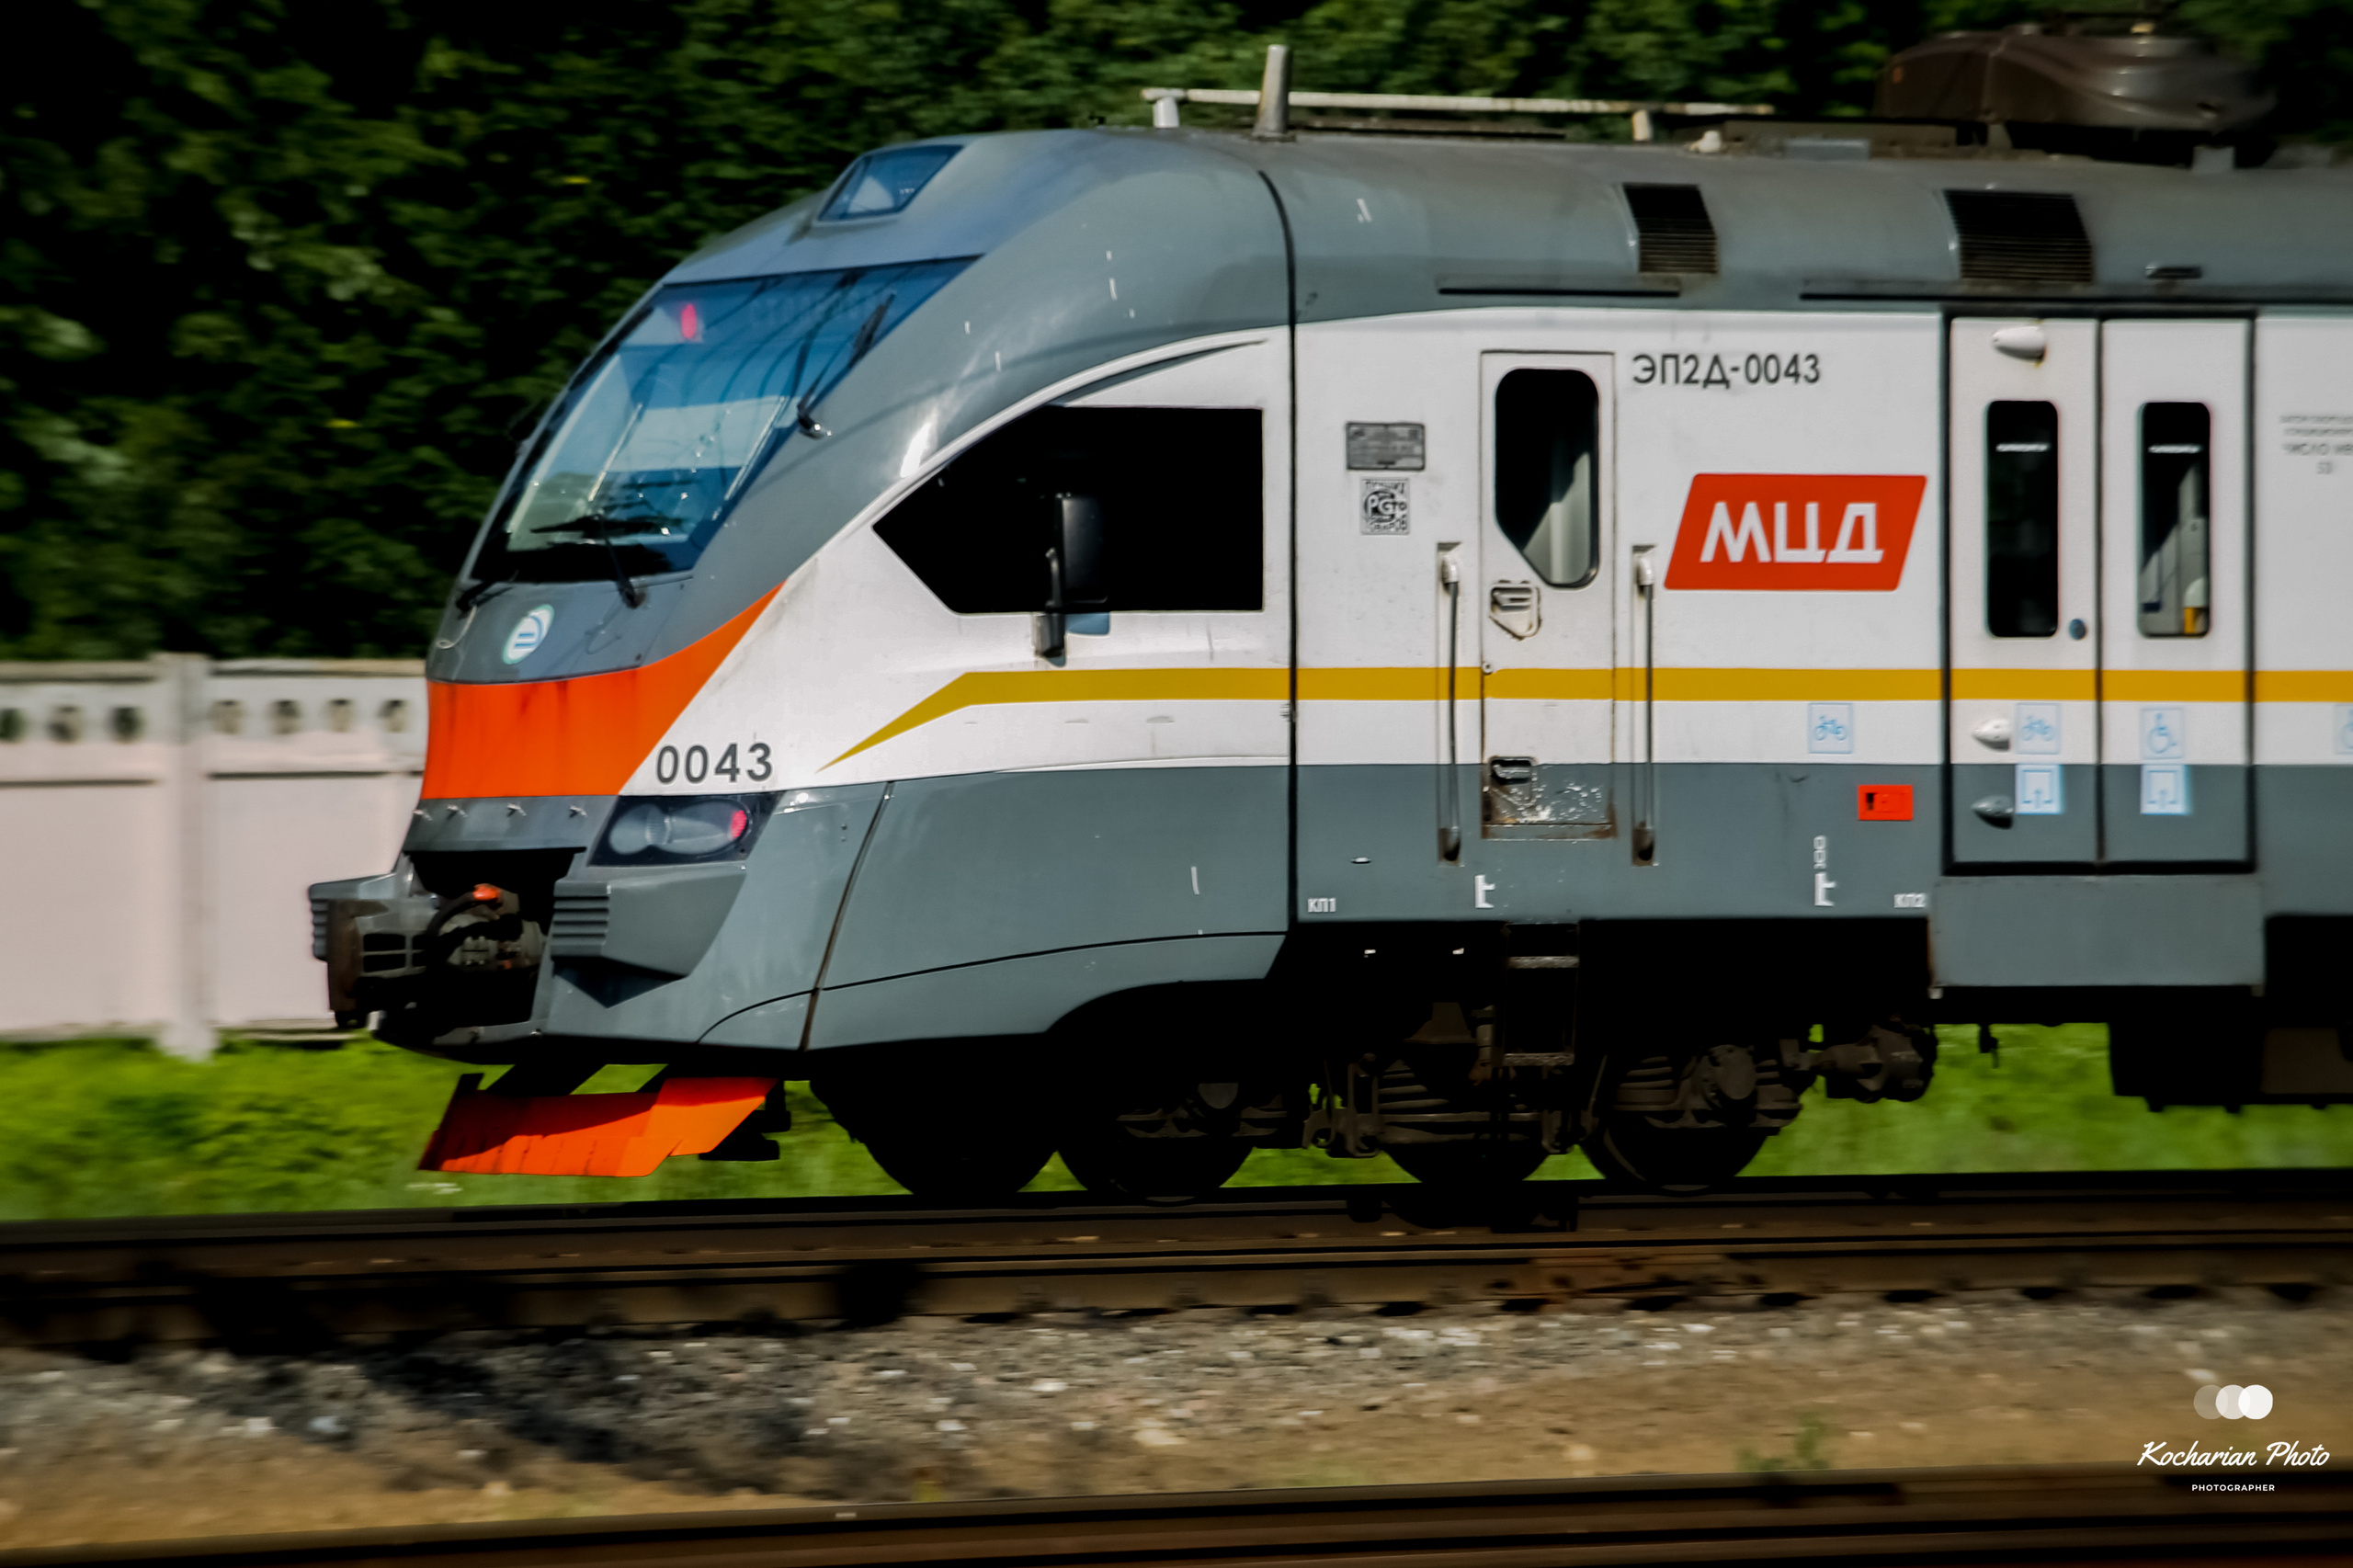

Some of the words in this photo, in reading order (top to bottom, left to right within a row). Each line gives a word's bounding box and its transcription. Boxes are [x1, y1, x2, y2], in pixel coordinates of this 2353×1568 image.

[1632, 353, 1820, 389] ЭП2Д-0043
[1700, 501, 1884, 563] МЦД
[656, 742, 773, 784] 0043
